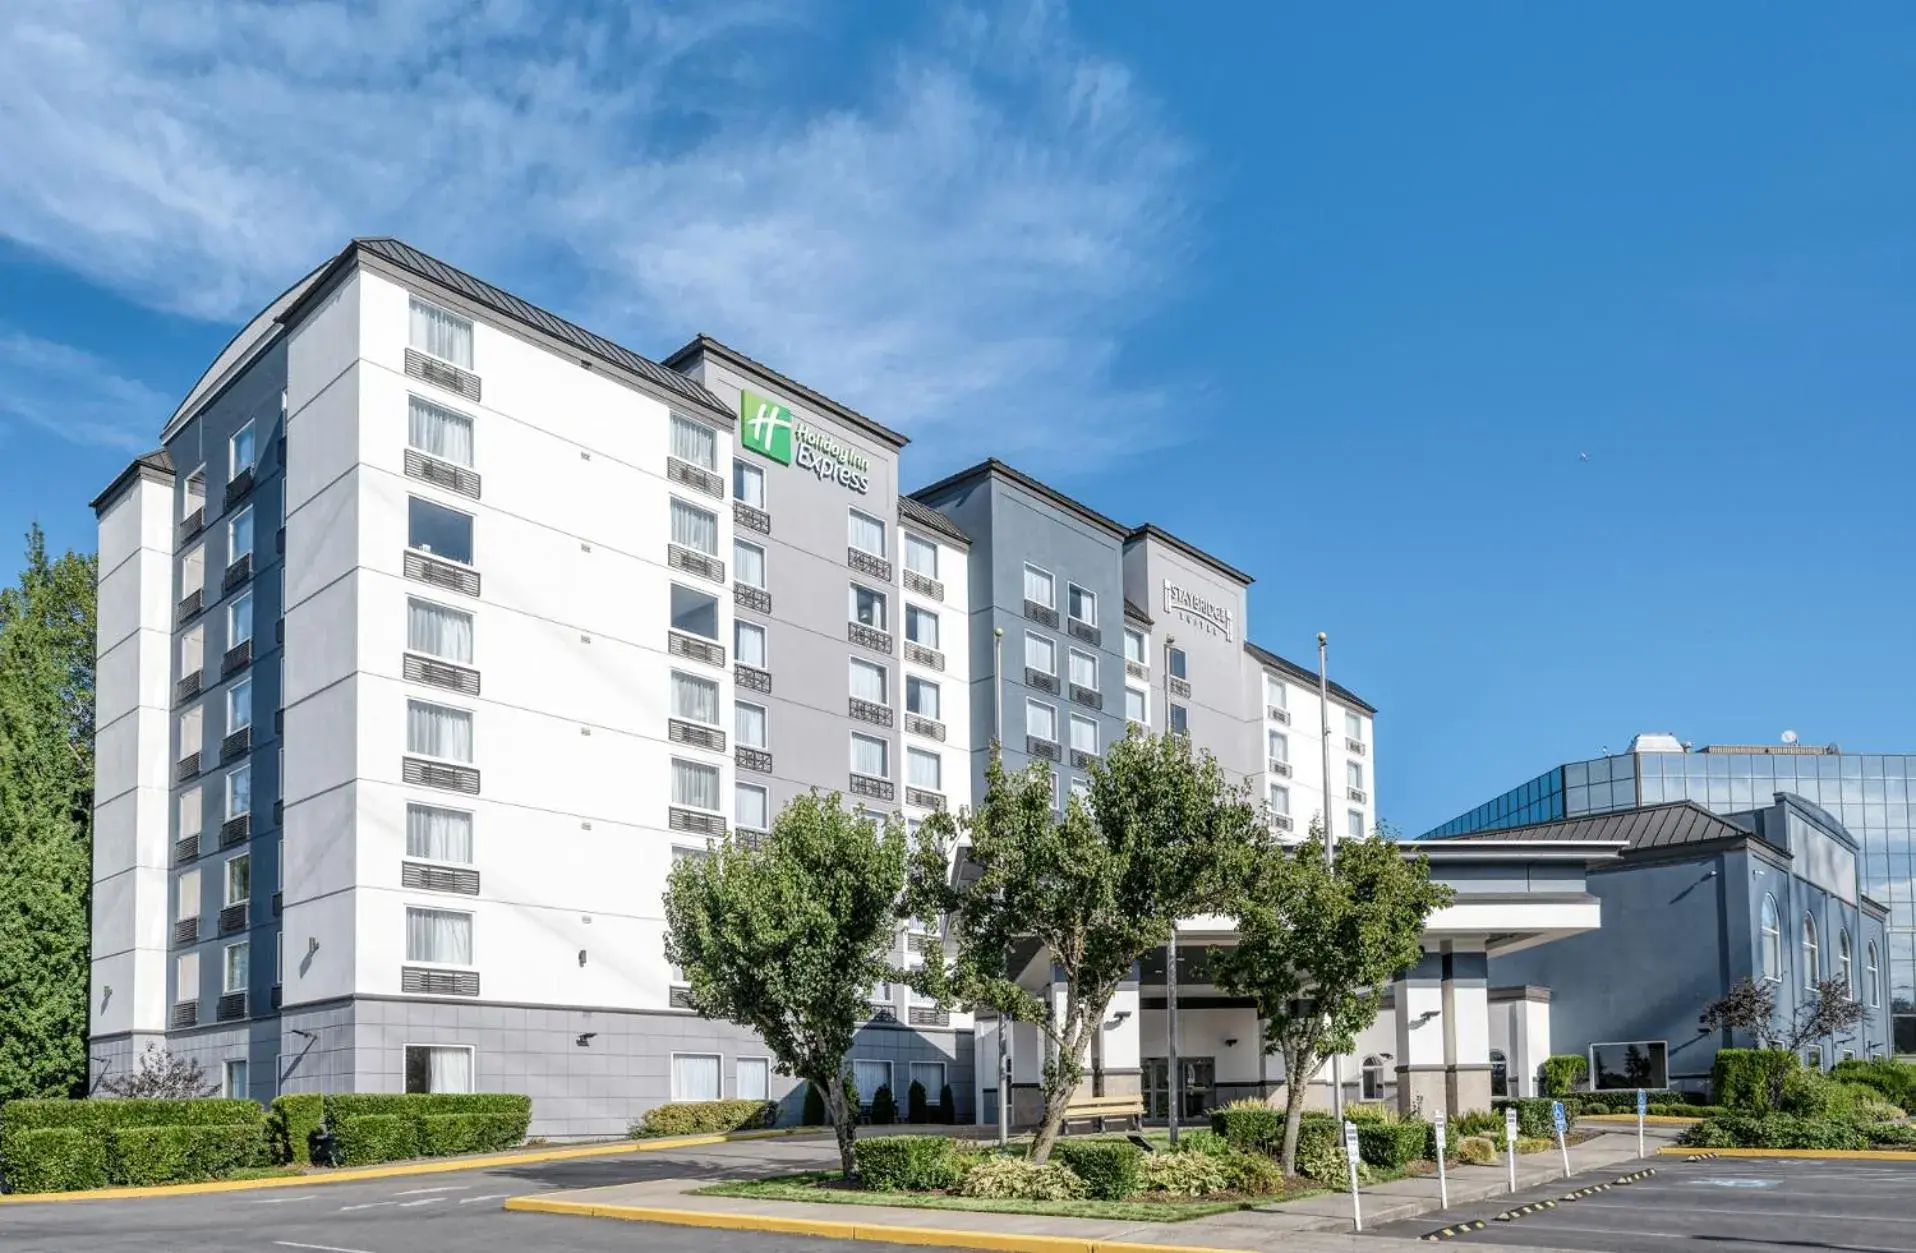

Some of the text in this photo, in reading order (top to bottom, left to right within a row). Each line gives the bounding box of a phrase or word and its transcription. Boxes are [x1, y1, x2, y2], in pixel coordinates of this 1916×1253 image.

[796, 422, 870, 472] Holiday Inn
[797, 442, 869, 495] Express
[1171, 585, 1226, 624] STAYBRIDGE
